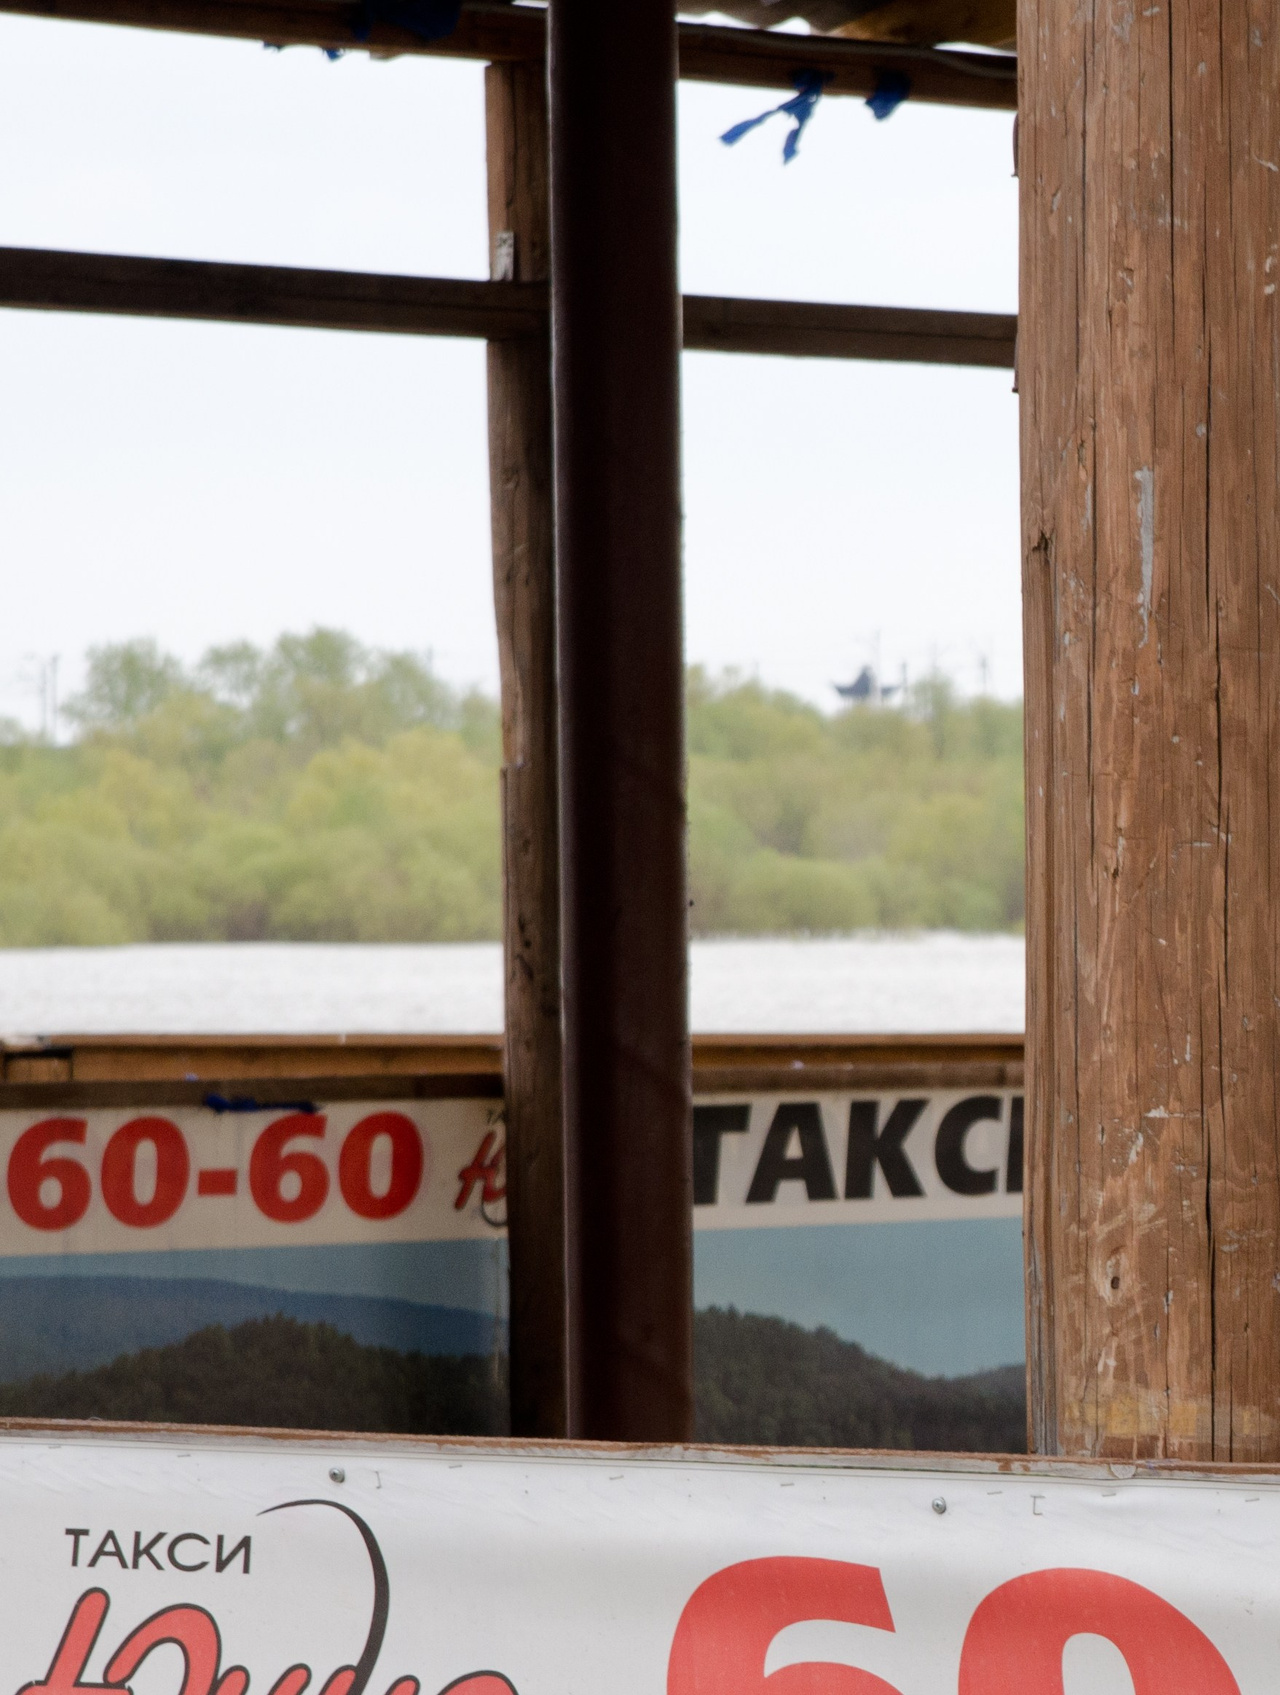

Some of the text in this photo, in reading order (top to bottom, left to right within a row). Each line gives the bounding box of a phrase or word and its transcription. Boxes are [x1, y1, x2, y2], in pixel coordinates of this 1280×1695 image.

[7, 1112, 424, 1231] 60-60
[692, 1095, 1024, 1206] ТАКС
[65, 1527, 252, 1575] ТАКСИ
